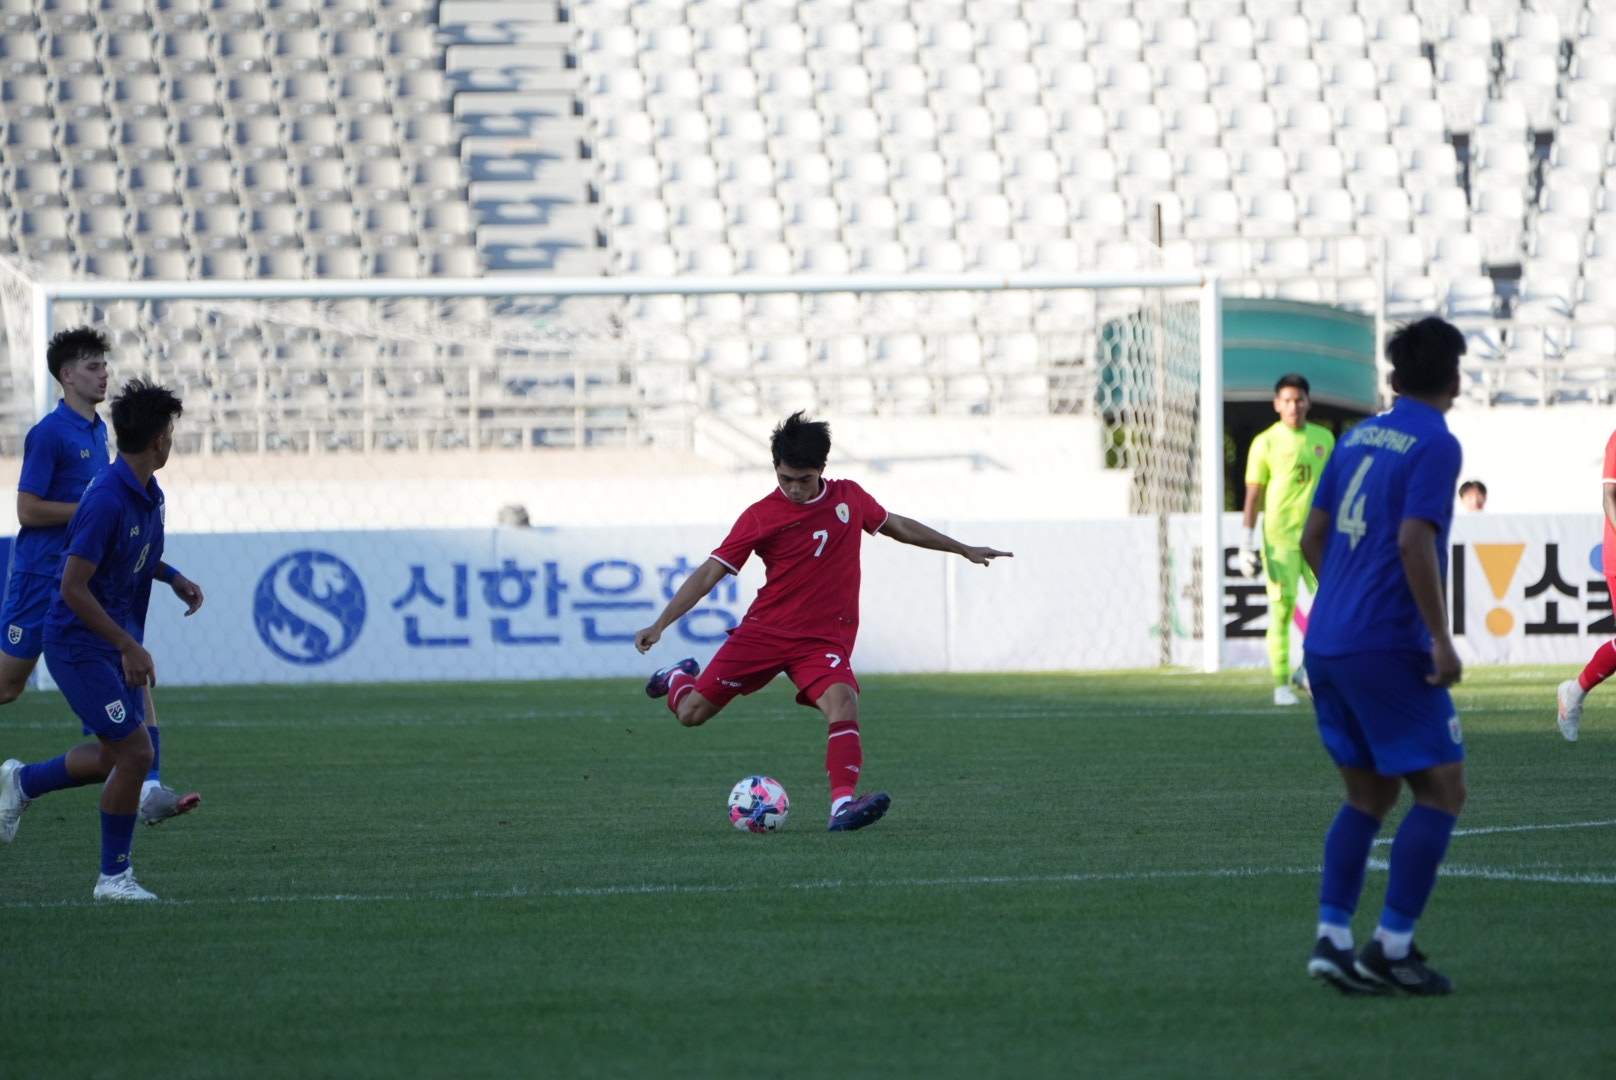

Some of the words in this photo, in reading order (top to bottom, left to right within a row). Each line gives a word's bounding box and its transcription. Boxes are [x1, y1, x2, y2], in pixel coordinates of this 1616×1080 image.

[1296, 464, 1312, 484] 31
[1336, 454, 1375, 551] 4
[133, 542, 150, 574] 8
[812, 529, 829, 558] 7
[391, 556, 739, 647] 신한은행
[825, 653, 841, 668] 7
